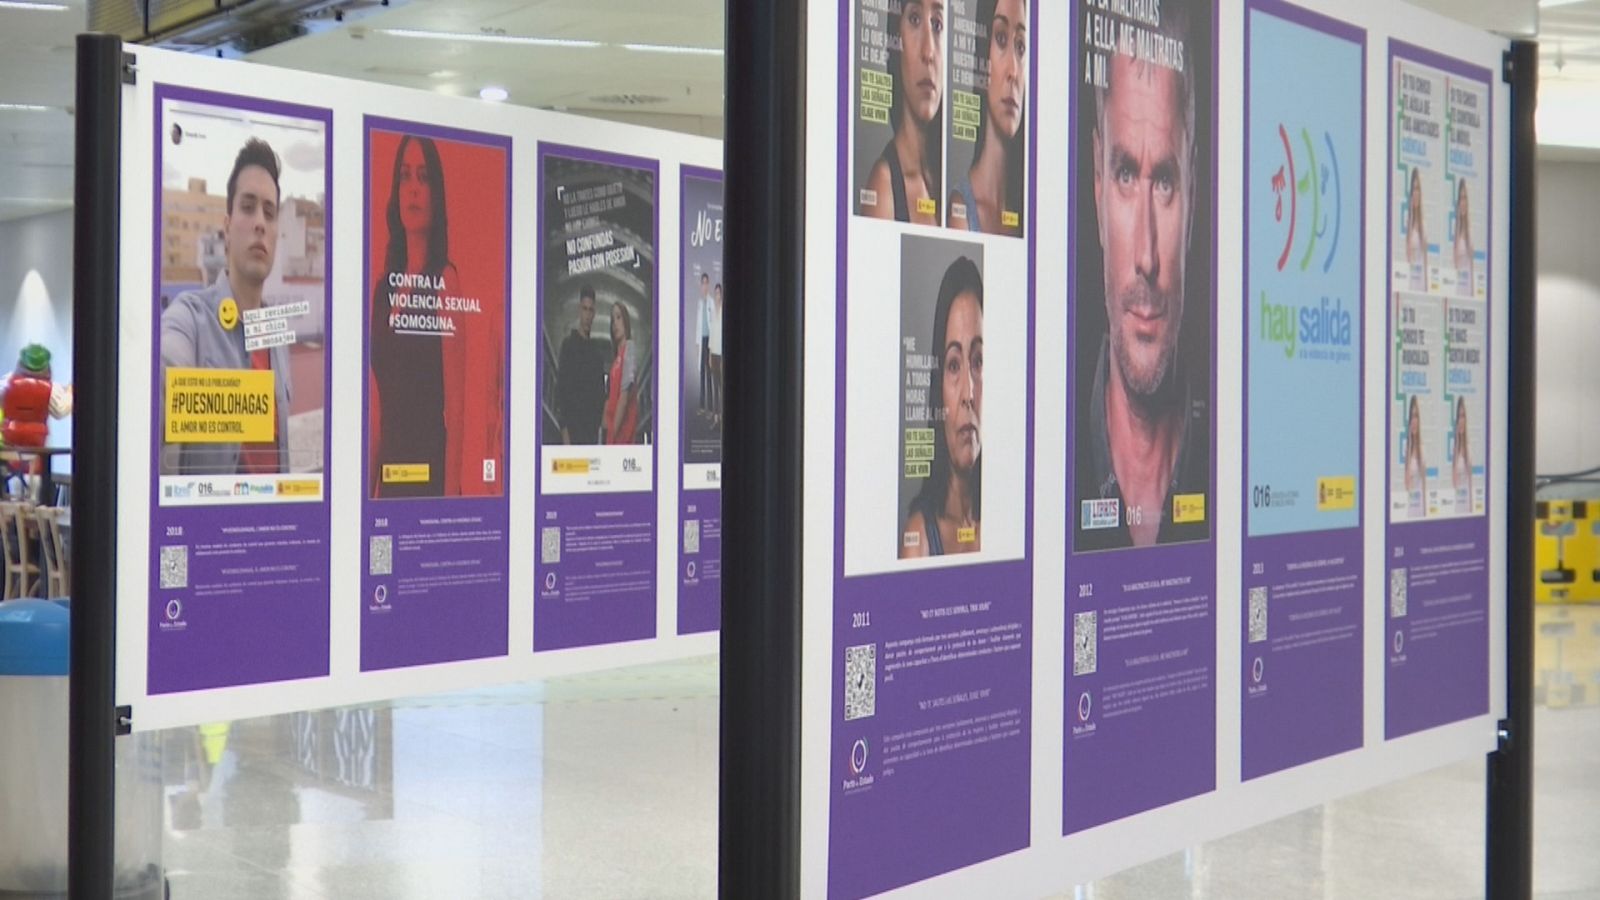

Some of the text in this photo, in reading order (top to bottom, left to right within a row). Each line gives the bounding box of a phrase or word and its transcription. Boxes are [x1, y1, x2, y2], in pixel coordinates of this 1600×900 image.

[861, 27, 869, 43] LO
[870, 30, 882, 47] QUE
[1085, 11, 1091, 45] A
[1119, 22, 1135, 57] ME
[1136, 27, 1183, 73] MALTRATAS
[861, 45, 869, 61] LE
[1085, 51, 1091, 84] A
[566, 230, 614, 255] NO CONFUNDAS
[592, 252, 605, 271] CON
[389, 272, 446, 290] CONTRA LA
[389, 292, 481, 313] VIOLENCIA SEXUAL
[389, 312, 457, 331] #SOMOSUNA.
[1260, 288, 1352, 360] hay salida
[912, 371, 931, 387] TODAS
[172, 391, 269, 415] #PUESNOLOHAGAS
[171, 420, 178, 434] EL
[180, 420, 198, 434] AMOR
[199, 420, 208, 434] NO
[208, 420, 217, 434] ES
[623, 458, 636, 472] 016
[198, 482, 212, 496] 016
[1253, 484, 1271, 508] 016
[1126, 505, 1142, 526] 016
[1079, 583, 1093, 597] 2012
[852, 610, 870, 628] 2011
